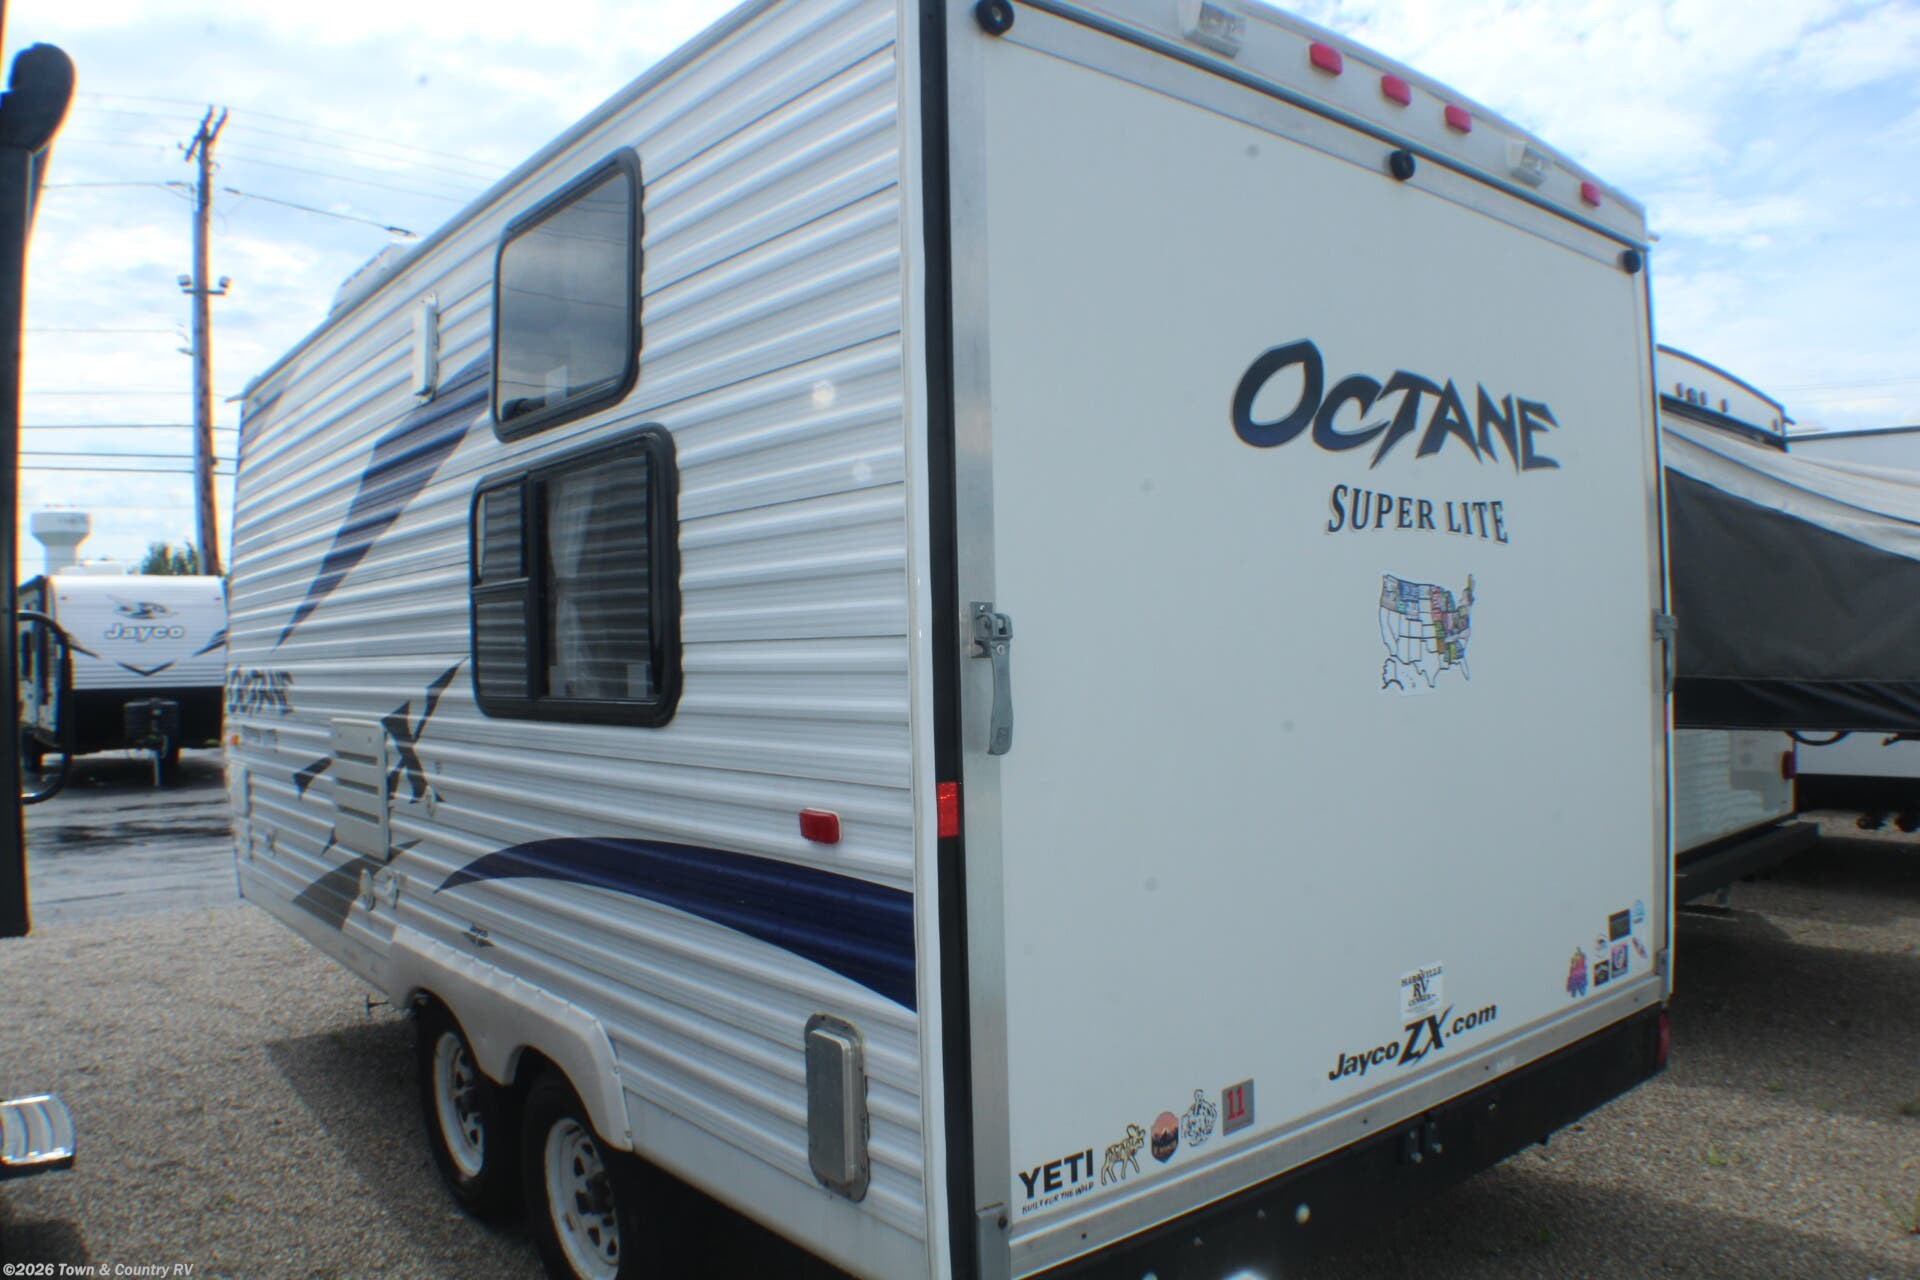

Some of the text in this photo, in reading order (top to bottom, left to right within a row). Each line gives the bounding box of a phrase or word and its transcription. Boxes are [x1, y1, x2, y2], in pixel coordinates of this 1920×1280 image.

[1230, 338, 1561, 475] OCTANE
[1327, 483, 1509, 545] SUPER LITE
[105, 623, 185, 642] Jayco
[1018, 1148, 1093, 1200] YETI
